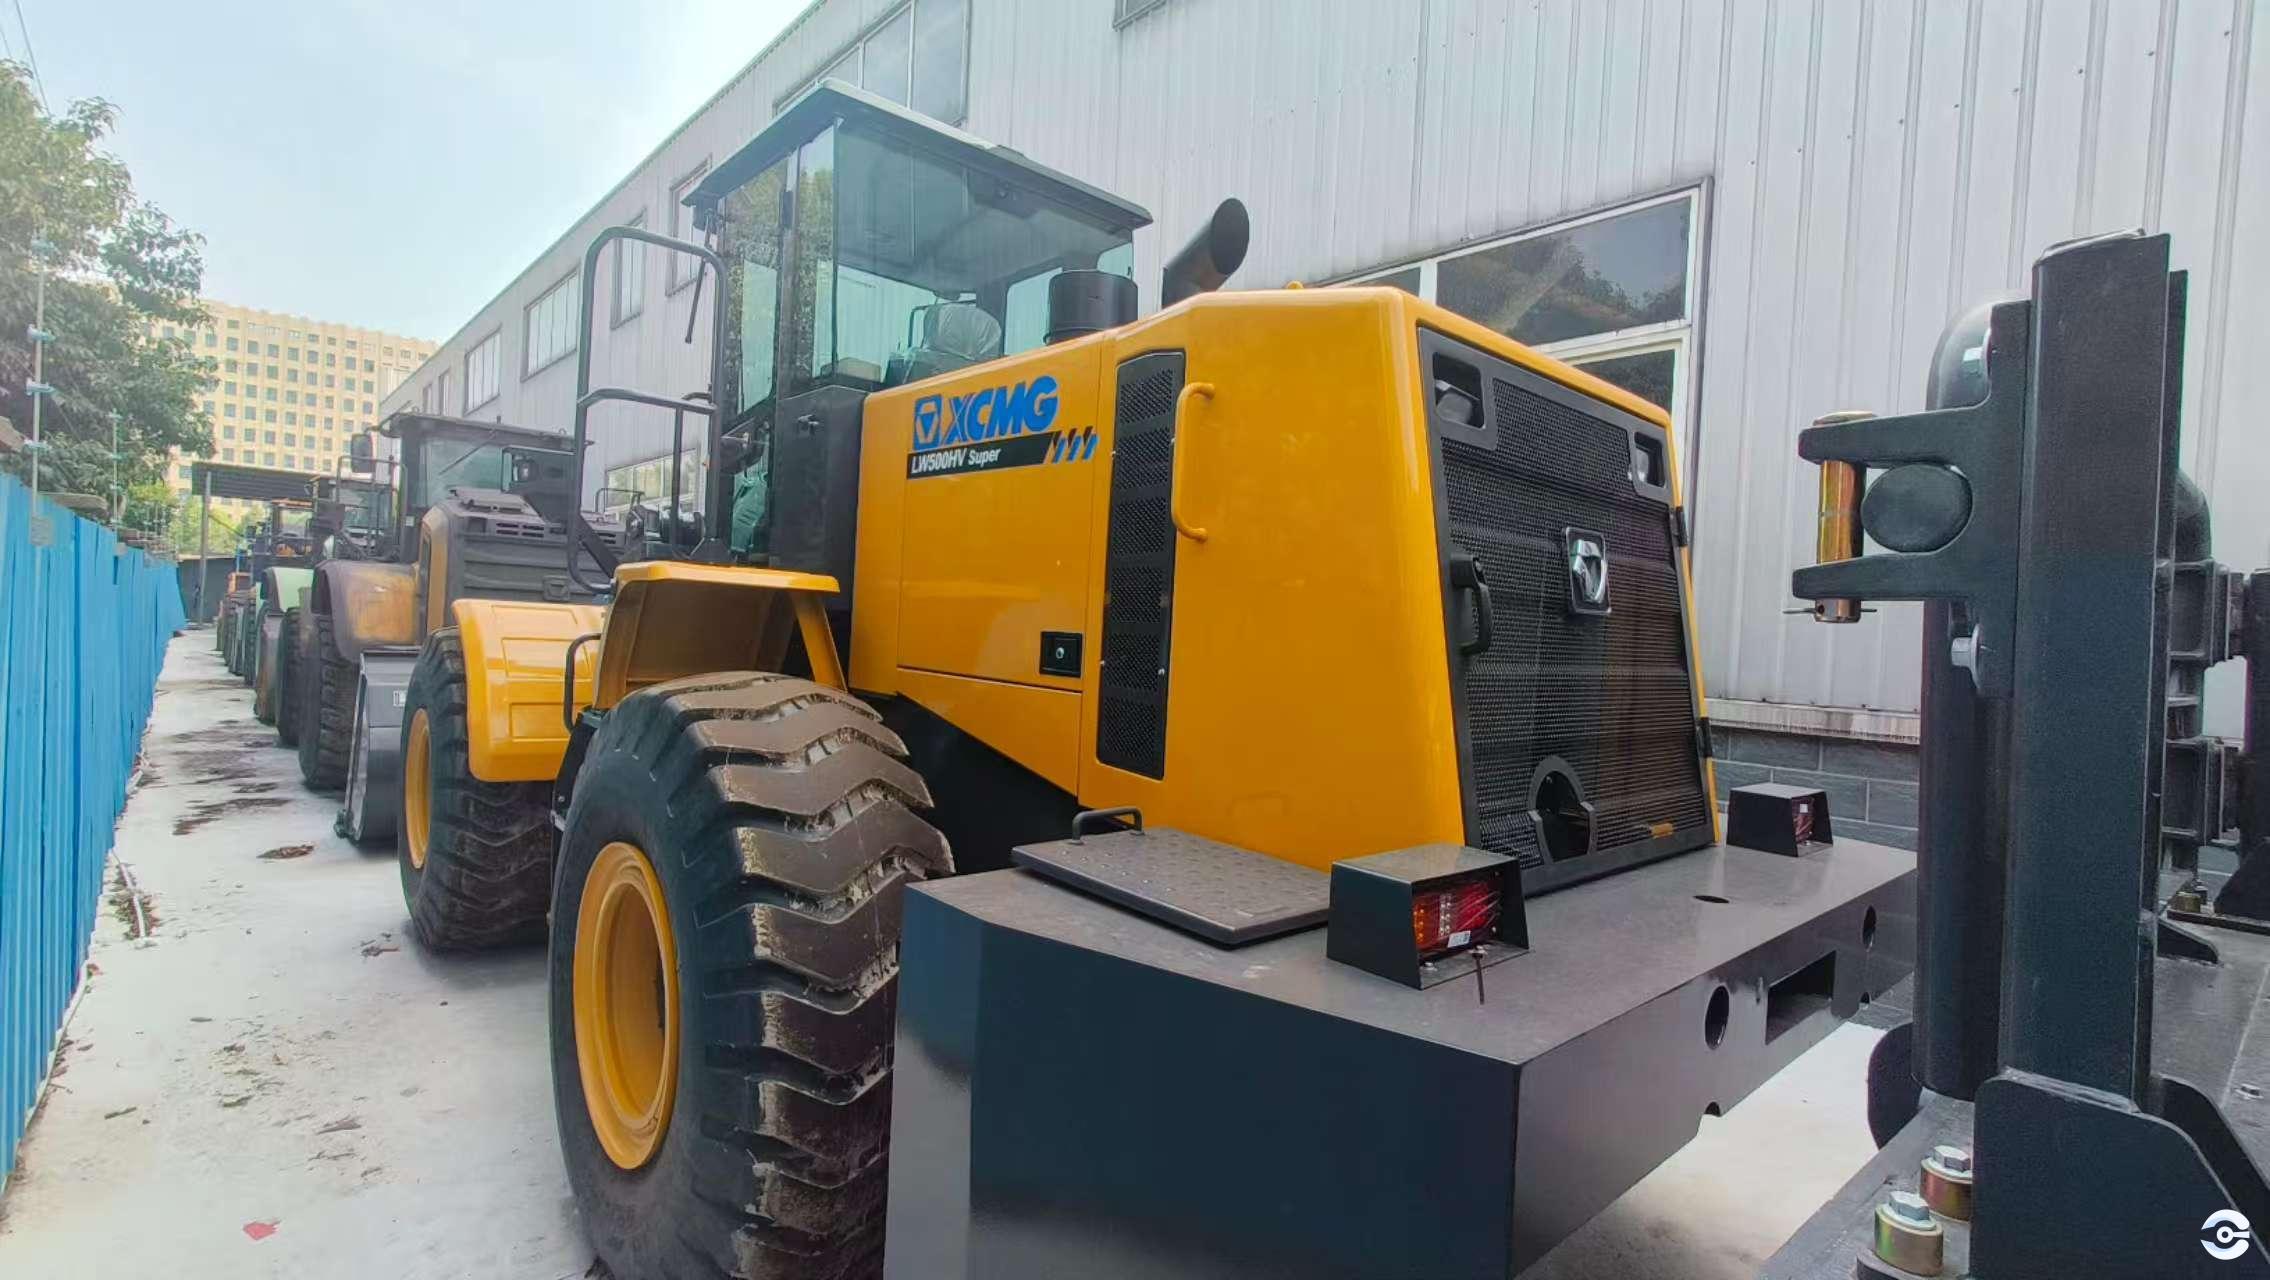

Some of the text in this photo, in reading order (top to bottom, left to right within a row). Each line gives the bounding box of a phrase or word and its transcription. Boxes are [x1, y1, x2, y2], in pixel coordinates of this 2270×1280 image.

[944, 375, 1060, 446] XCMG
[911, 447, 1001, 474] LW500HV Super
